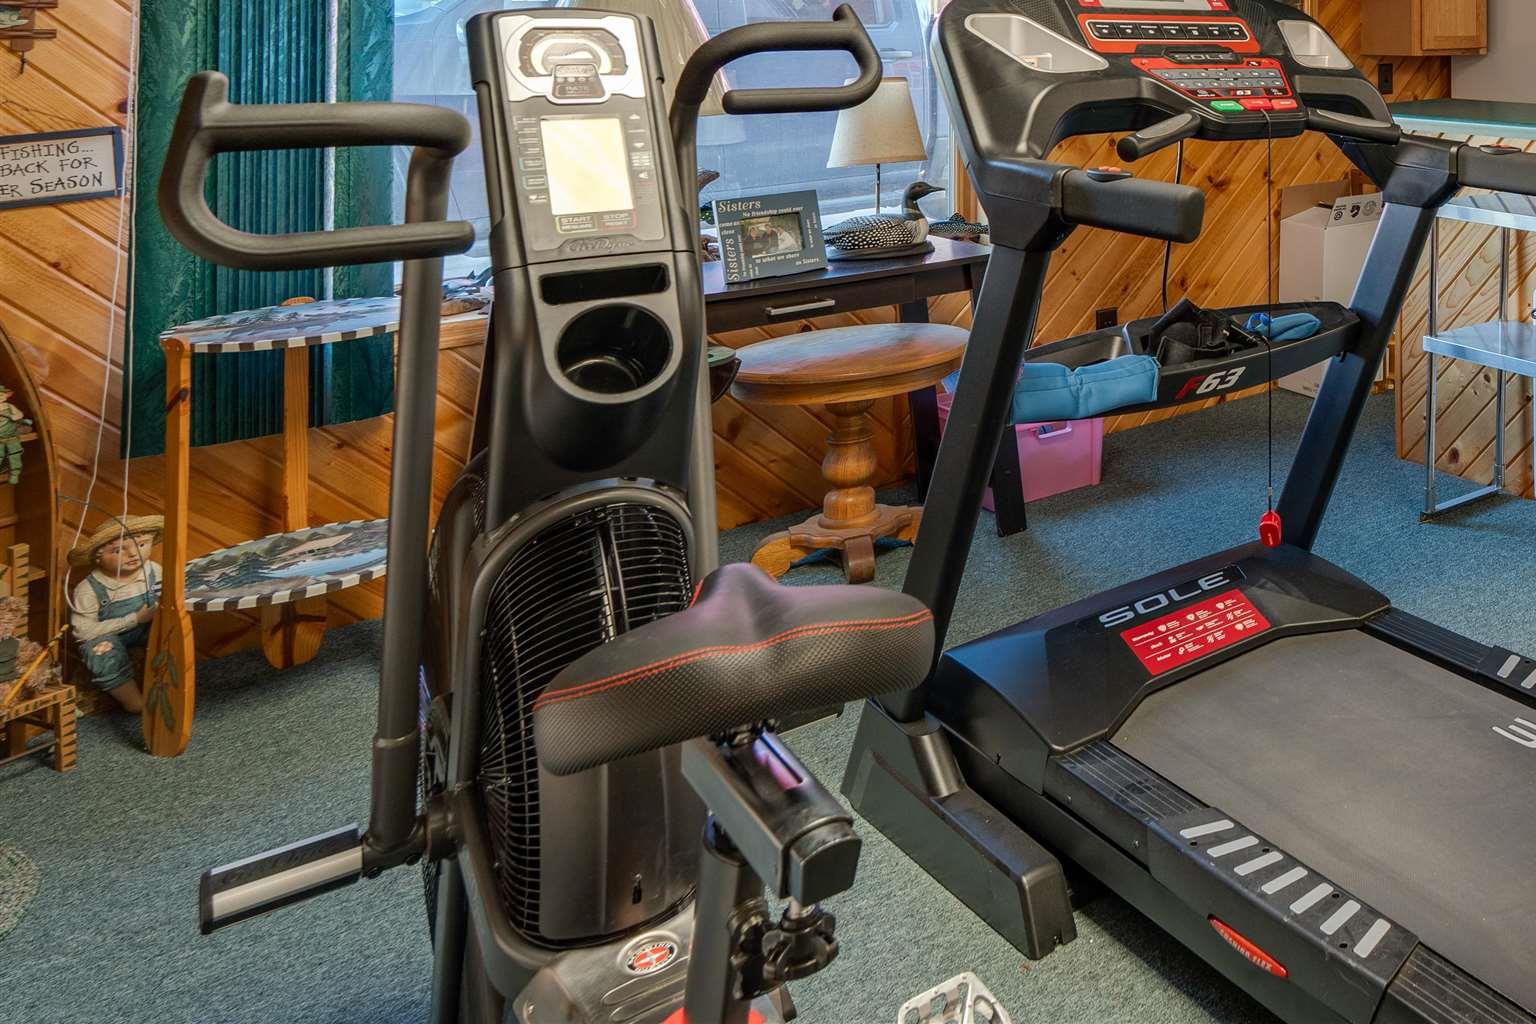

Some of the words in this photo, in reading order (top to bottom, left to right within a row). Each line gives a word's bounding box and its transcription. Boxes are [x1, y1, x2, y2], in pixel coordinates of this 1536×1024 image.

[0, 160, 49, 176] BACK
[59, 157, 98, 171] FOR
[30, 171, 103, 194] SEASON
[718, 200, 761, 213] Sisters
[1174, 367, 1247, 401] F63
[1099, 571, 1231, 628] SOLE
